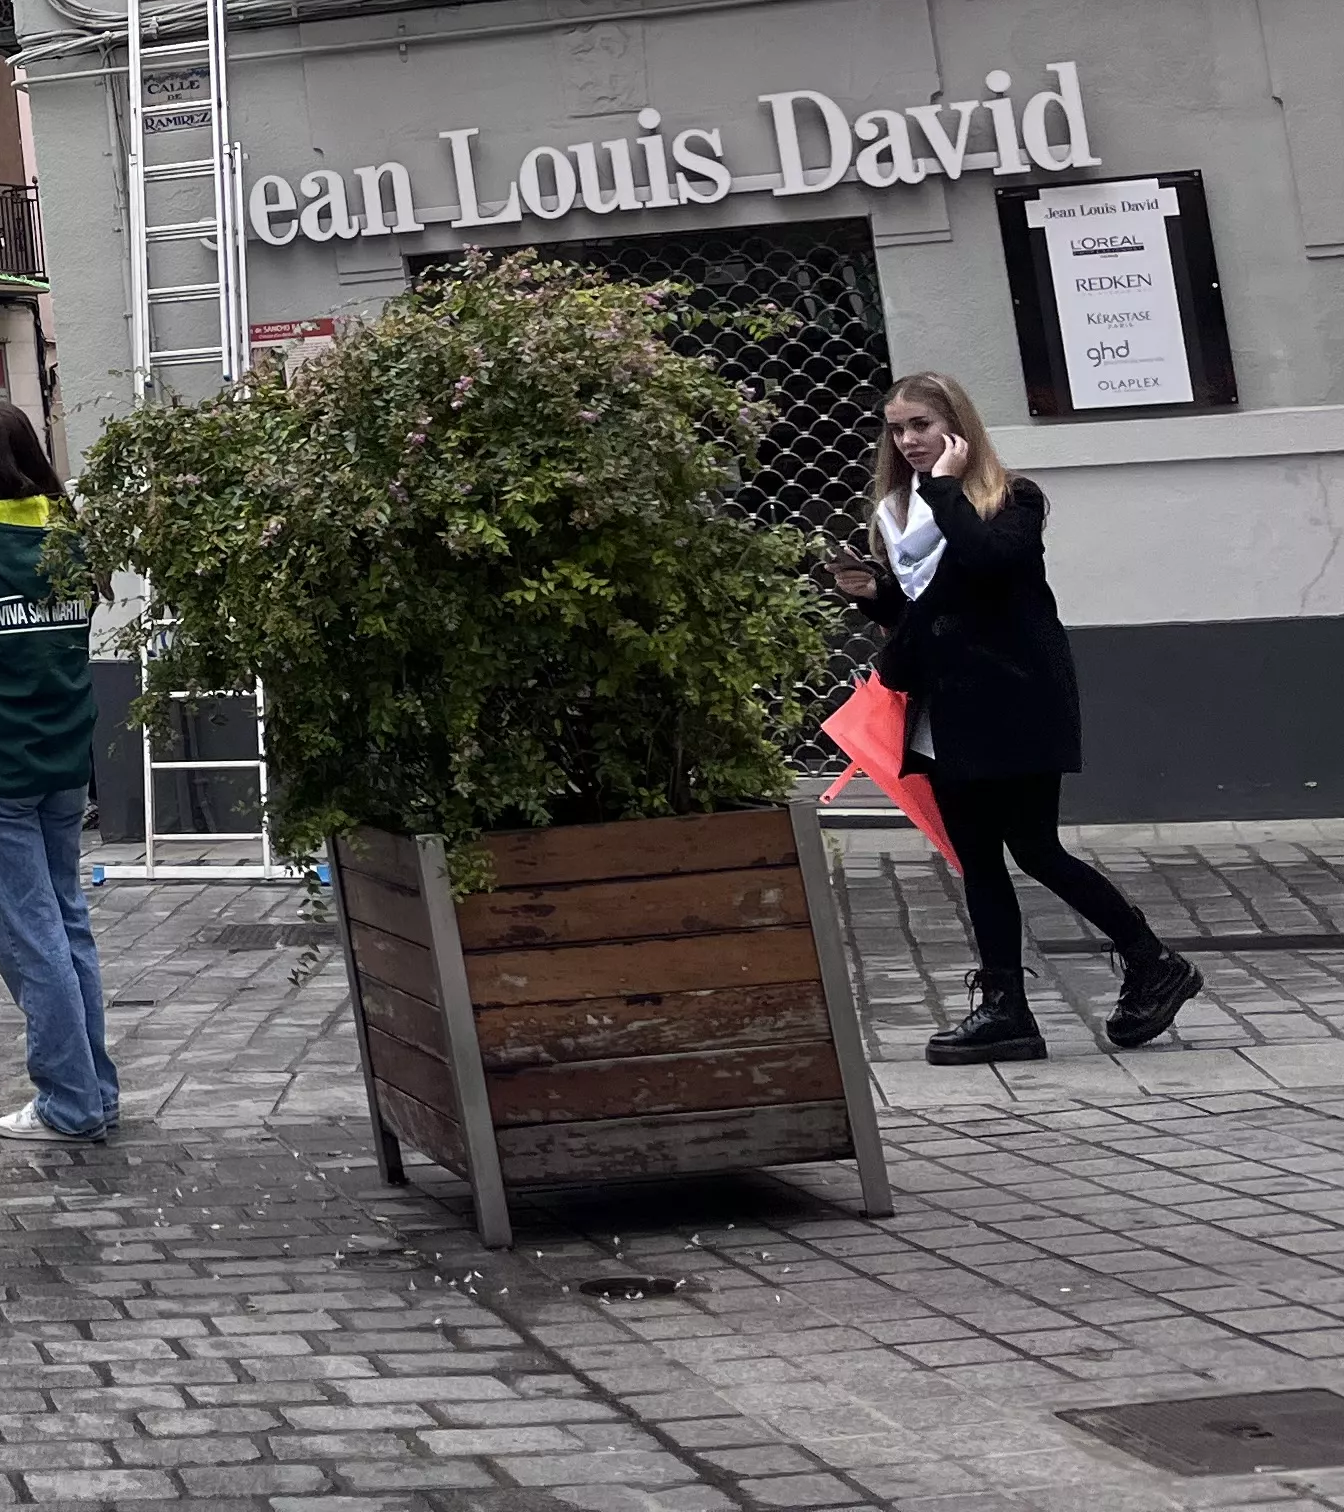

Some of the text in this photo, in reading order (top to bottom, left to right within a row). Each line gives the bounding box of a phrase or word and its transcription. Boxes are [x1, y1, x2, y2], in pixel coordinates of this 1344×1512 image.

[146, 79, 201, 95] CALLE
[167, 93, 182, 101] DE
[199, 61, 1103, 250] ean Louis David
[1043, 198, 1160, 220] Jean Louis David
[1075, 273, 1153, 292] REDKEN
[1086, 339, 1130, 368] ghd
[1097, 376, 1162, 391] OLAPLEX
